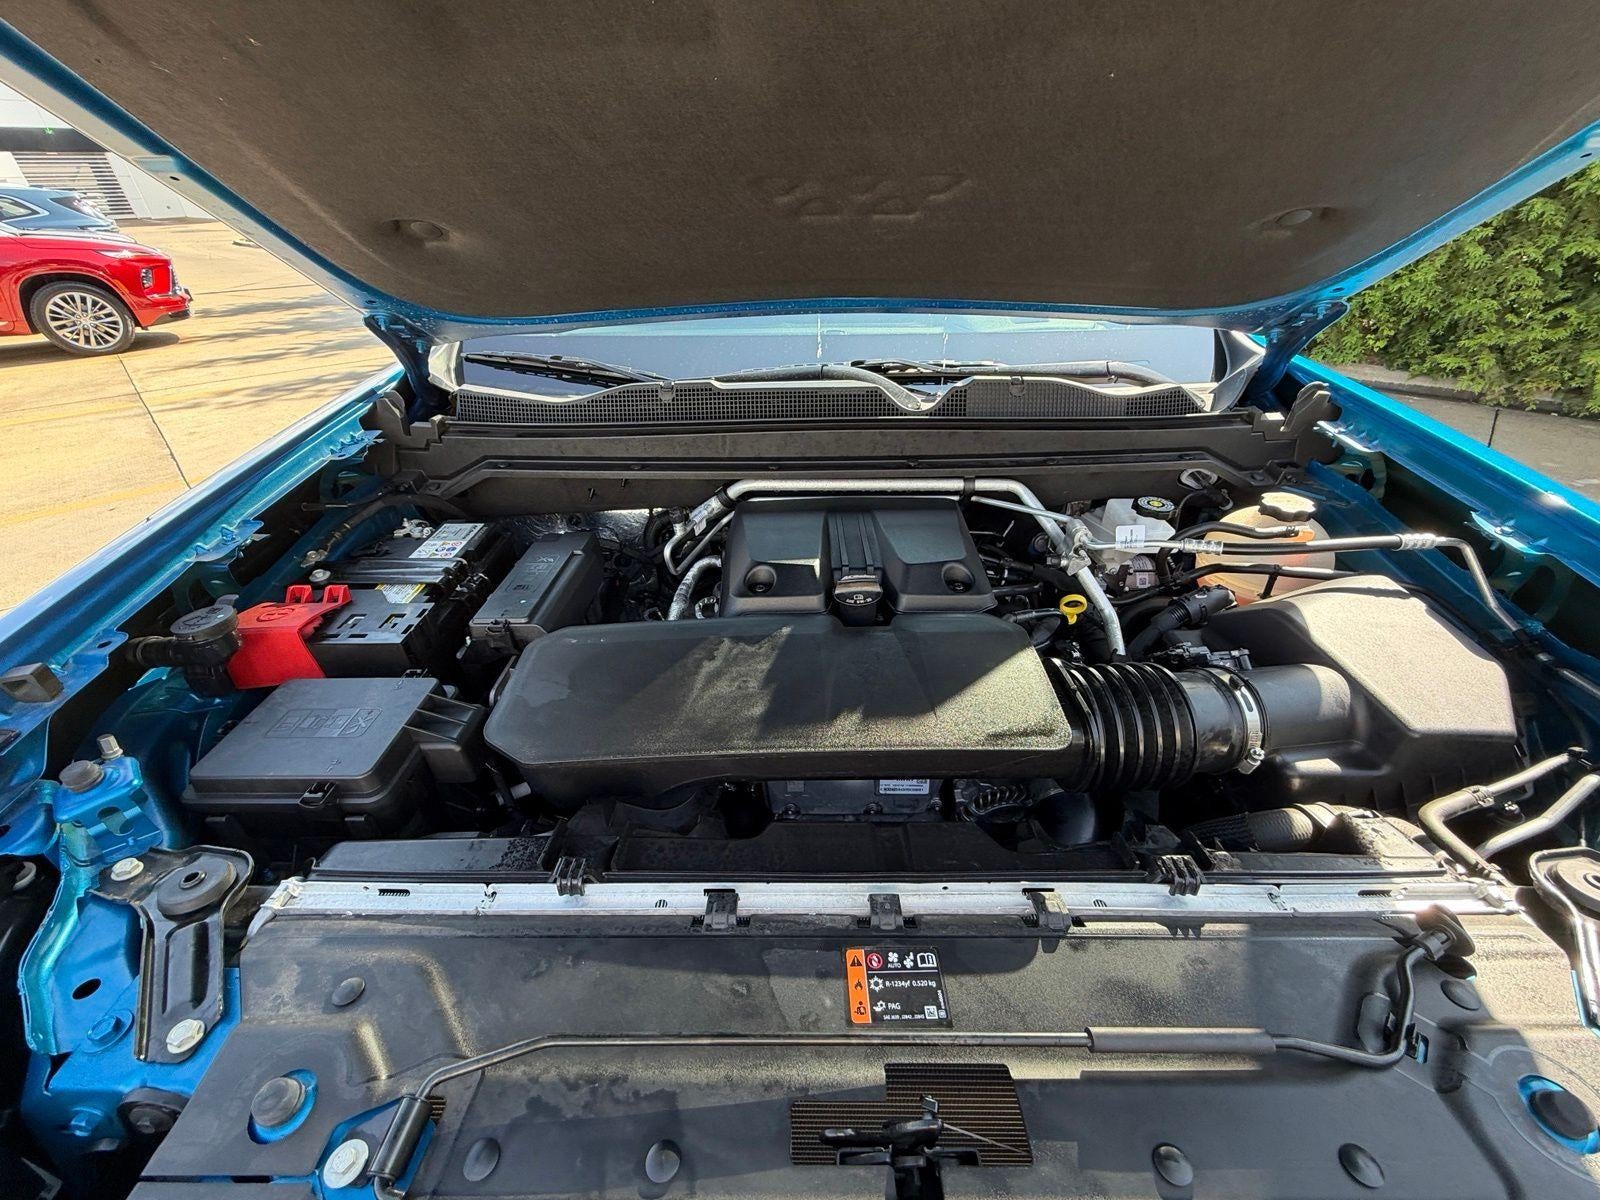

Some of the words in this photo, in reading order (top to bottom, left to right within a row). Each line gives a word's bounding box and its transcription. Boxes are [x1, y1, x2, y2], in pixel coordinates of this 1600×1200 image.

[885, 980, 911, 988] R-1234yf
[928, 980, 936, 988] kg
[888, 1002, 901, 1010] PAG
